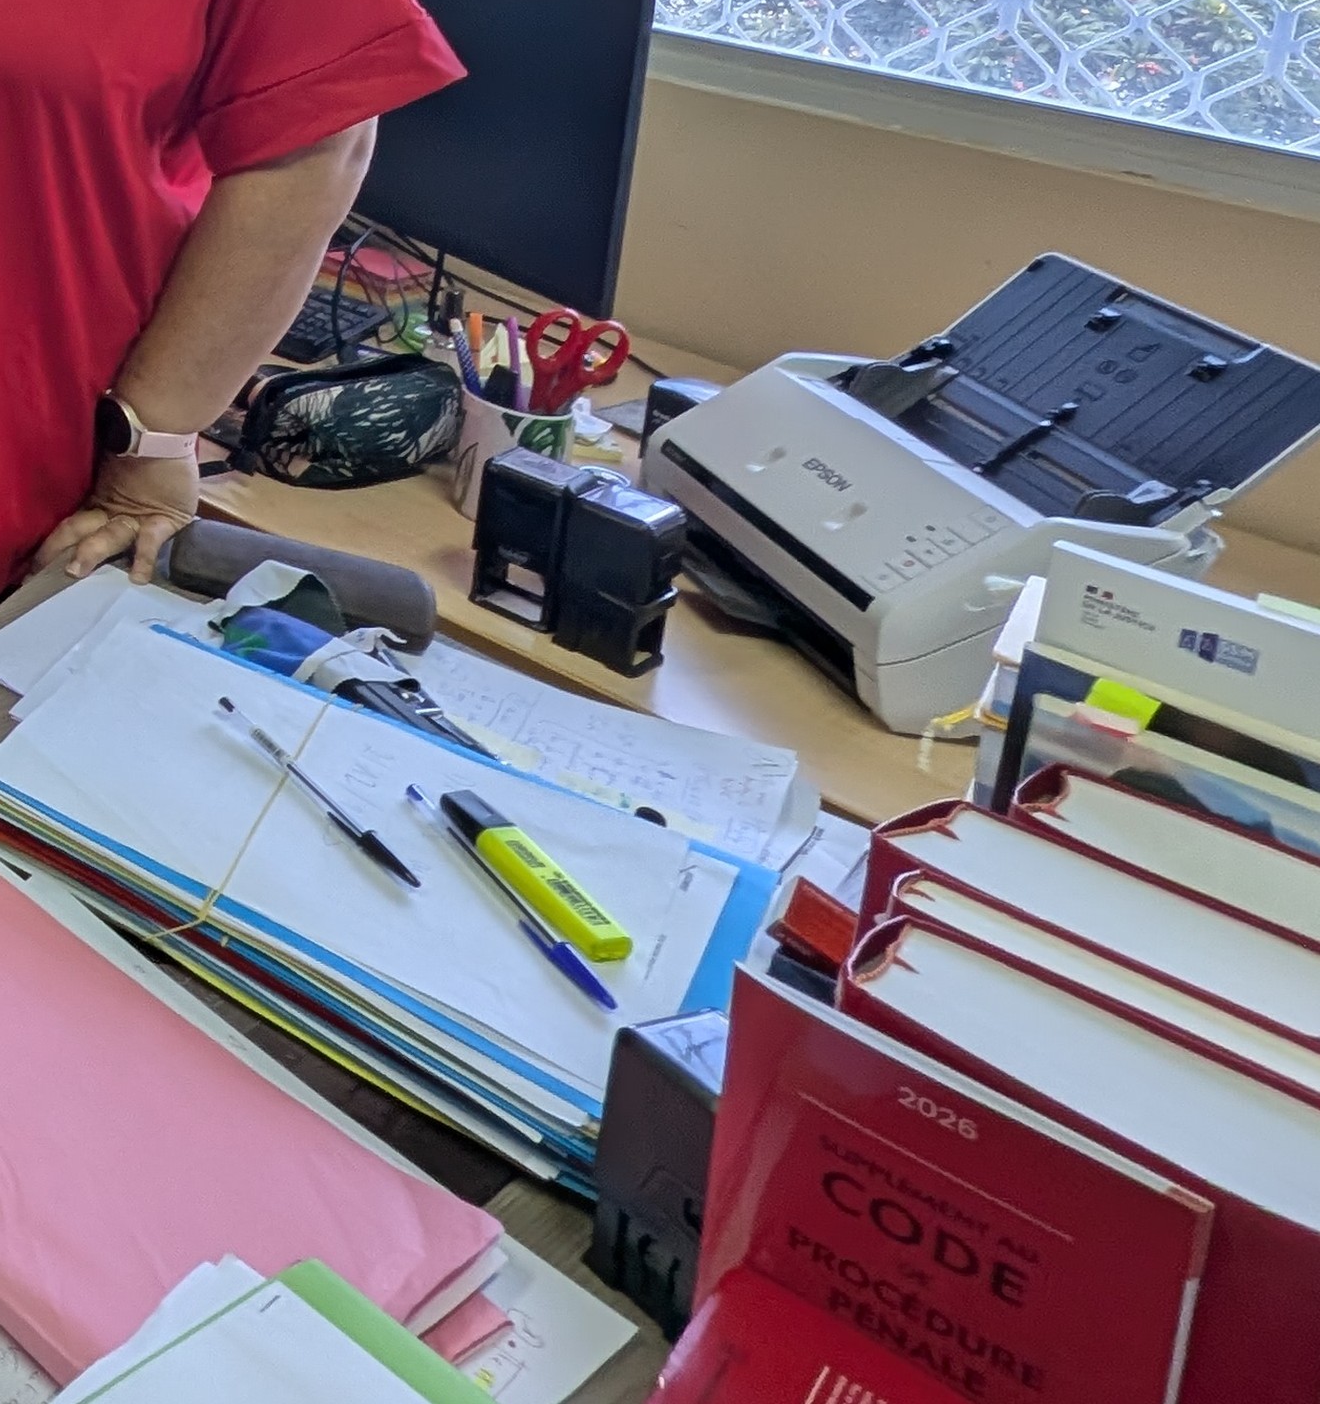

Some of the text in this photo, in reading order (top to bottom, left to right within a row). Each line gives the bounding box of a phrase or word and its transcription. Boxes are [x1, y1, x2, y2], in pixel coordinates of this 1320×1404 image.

[802, 458, 854, 492] EPSON
[897, 1086, 979, 1141] 2026
[821, 1170, 1030, 1309] CODE
